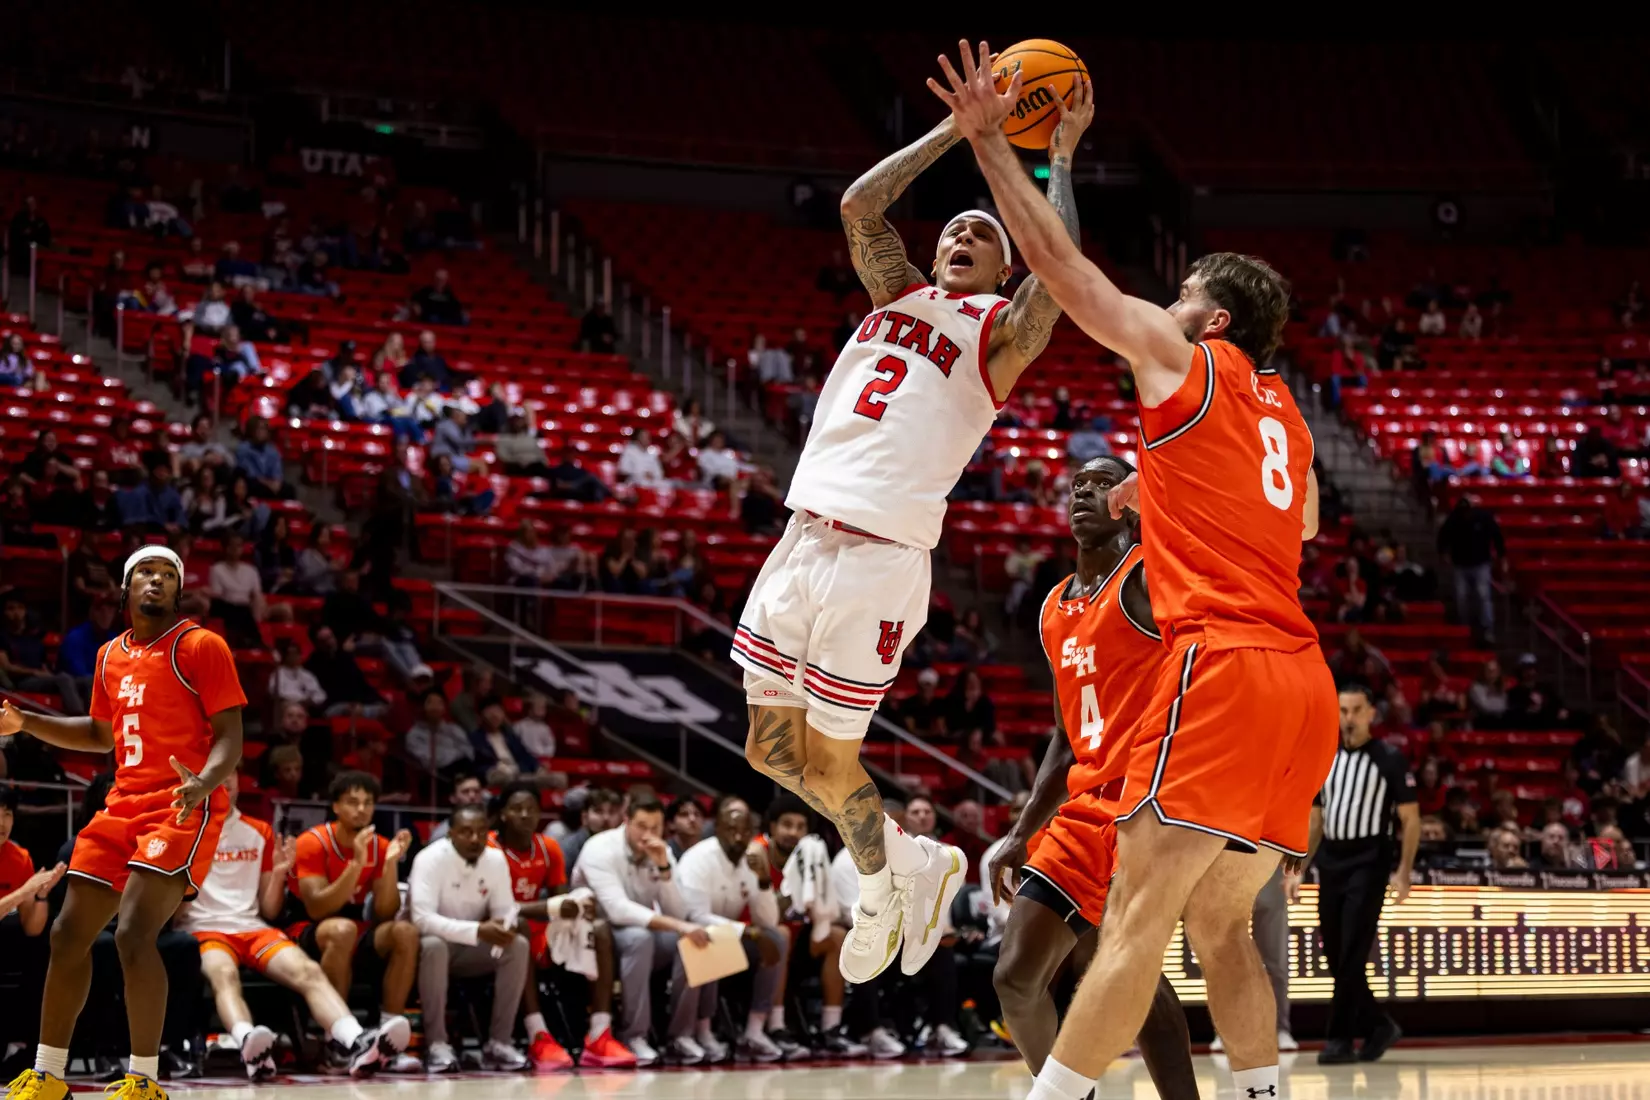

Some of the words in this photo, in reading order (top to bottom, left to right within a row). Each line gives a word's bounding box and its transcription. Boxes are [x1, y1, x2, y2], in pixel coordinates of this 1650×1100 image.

[131, 124, 151, 149] N
[1009, 87, 1054, 119] Wil
[300, 146, 379, 177] UTA
[856, 310, 962, 379] UTAH
[853, 354, 908, 422] 2
[1258, 416, 1293, 511] 8
[122, 713, 143, 767] 5
[1080, 683, 1104, 750] 4
[1369, 905, 1650, 997] ppointment
